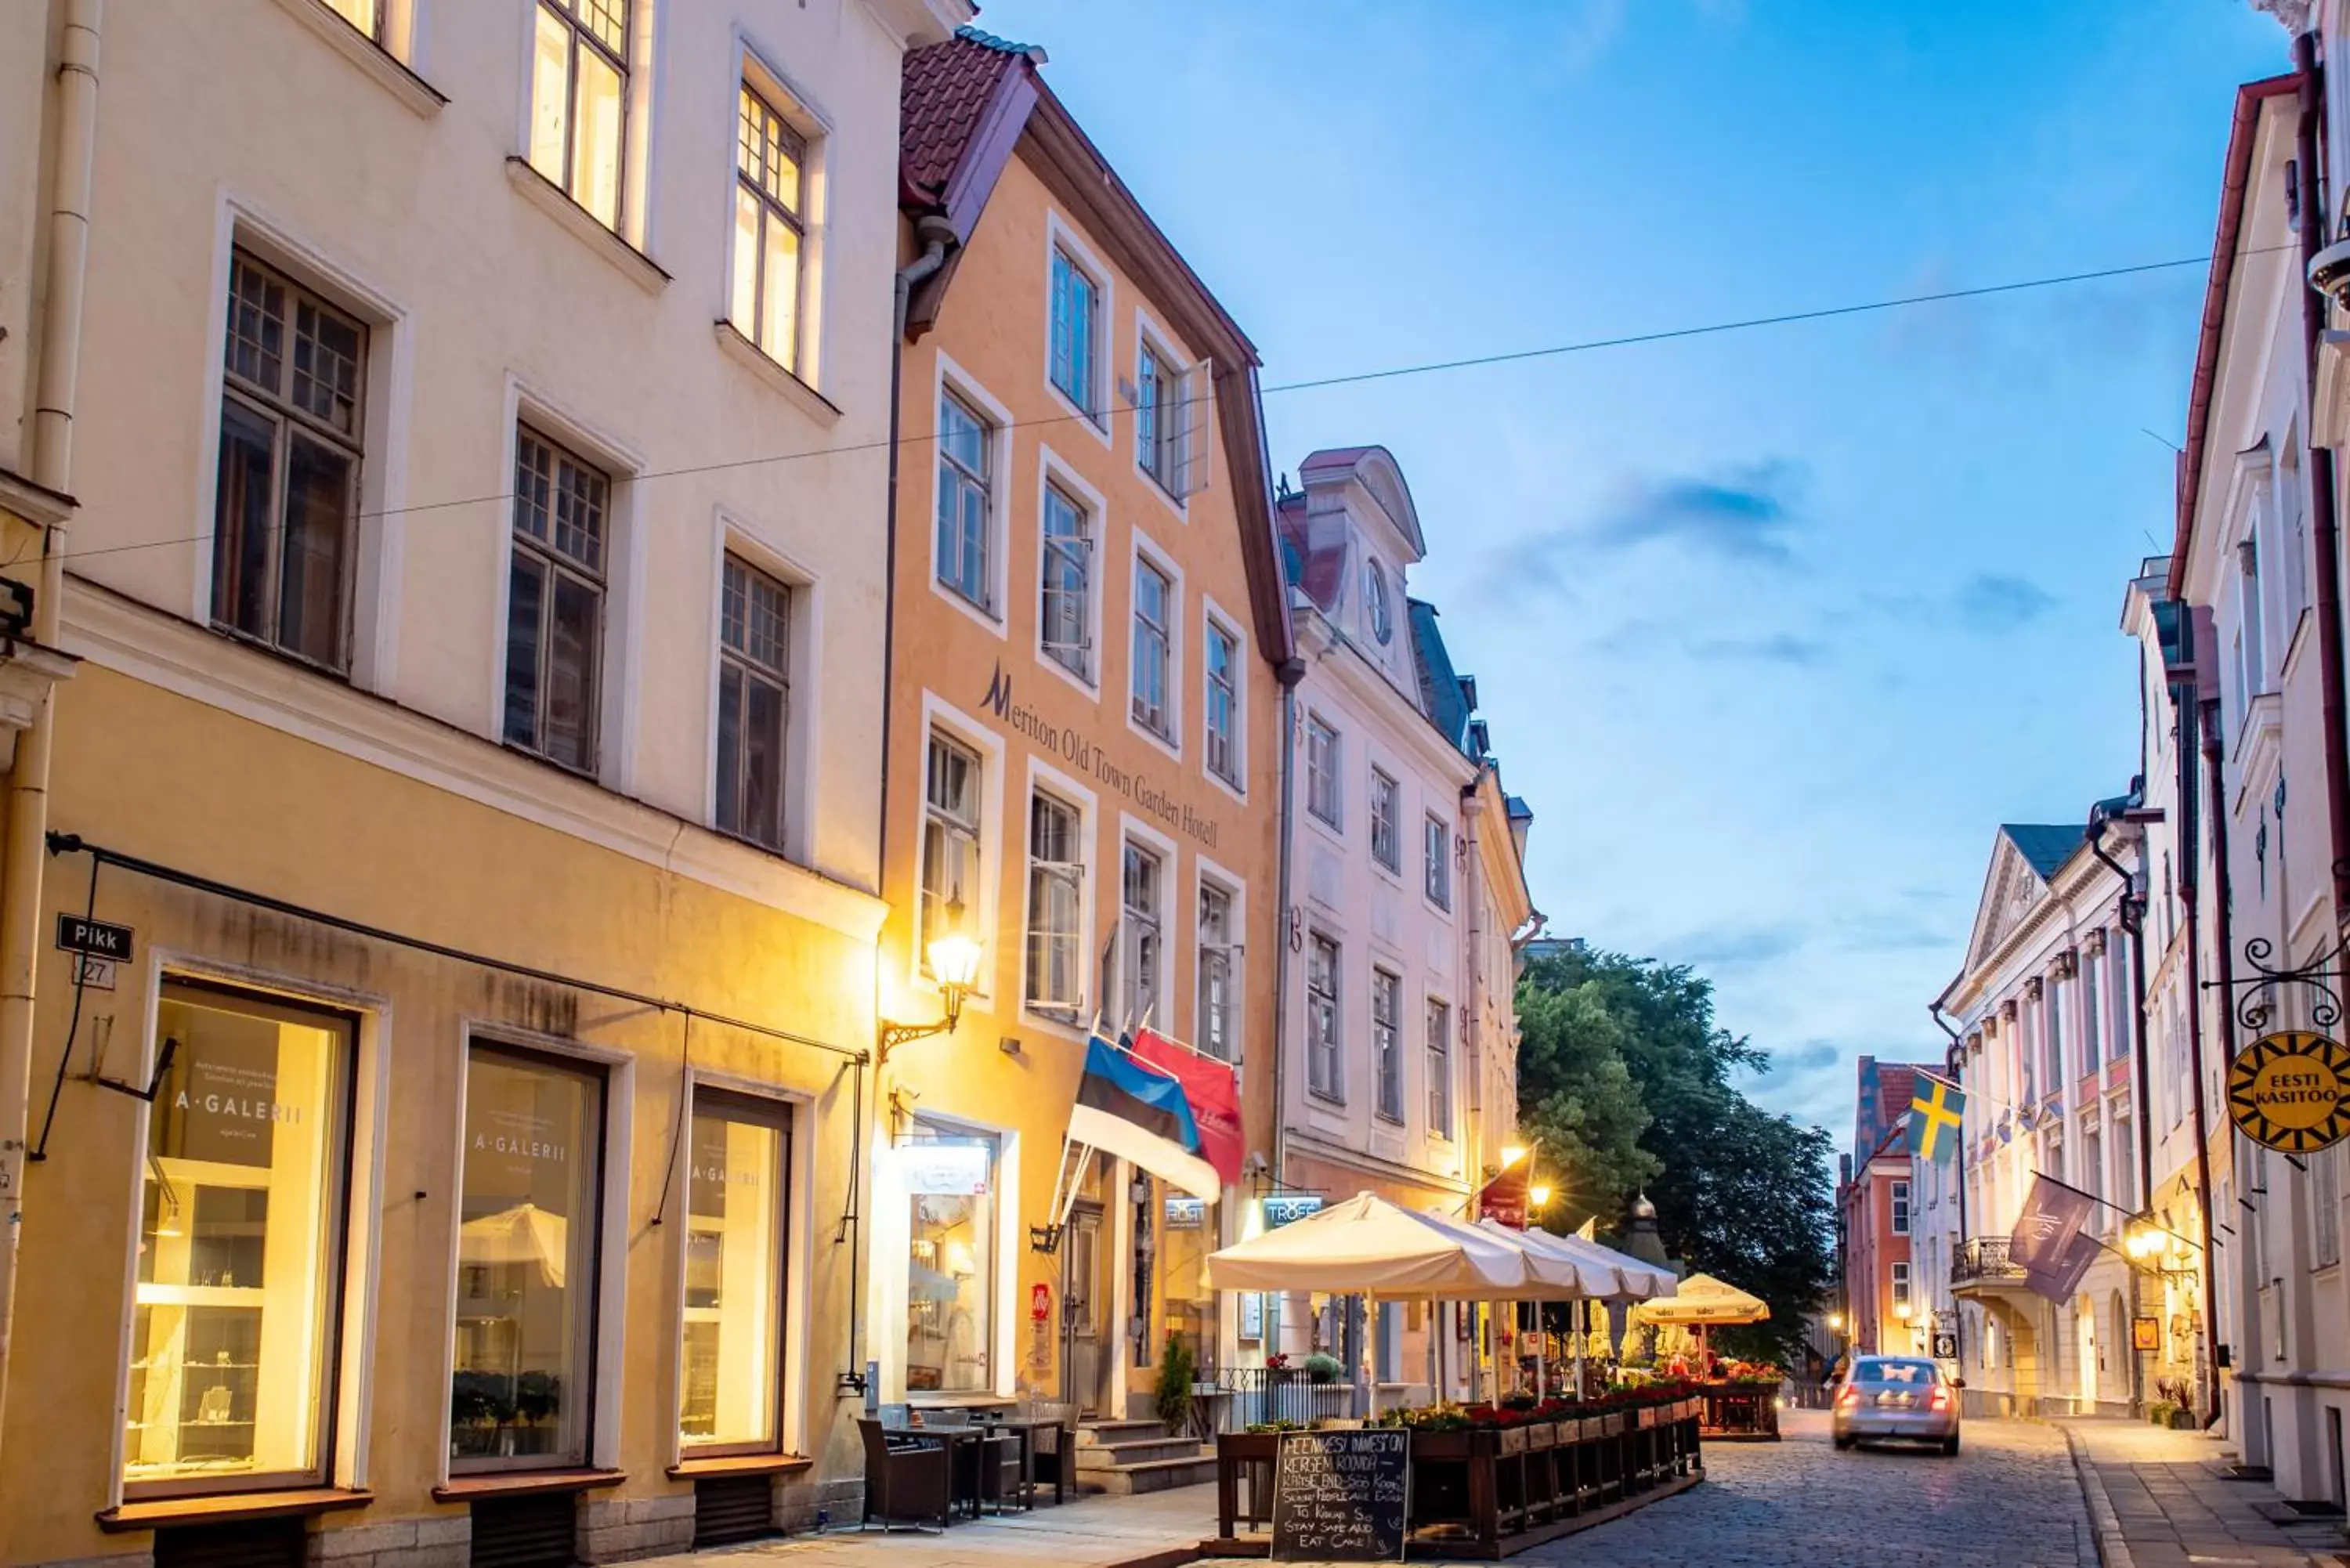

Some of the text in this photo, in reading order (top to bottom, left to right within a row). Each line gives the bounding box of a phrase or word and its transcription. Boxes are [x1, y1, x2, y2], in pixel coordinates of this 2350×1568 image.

[978, 656, 1217, 850] Meriton Old Town Garden Hotell
[74, 924, 118, 950] Pikk
[83, 960, 107, 982] 27
[2270, 1073, 2320, 1088] EESTI
